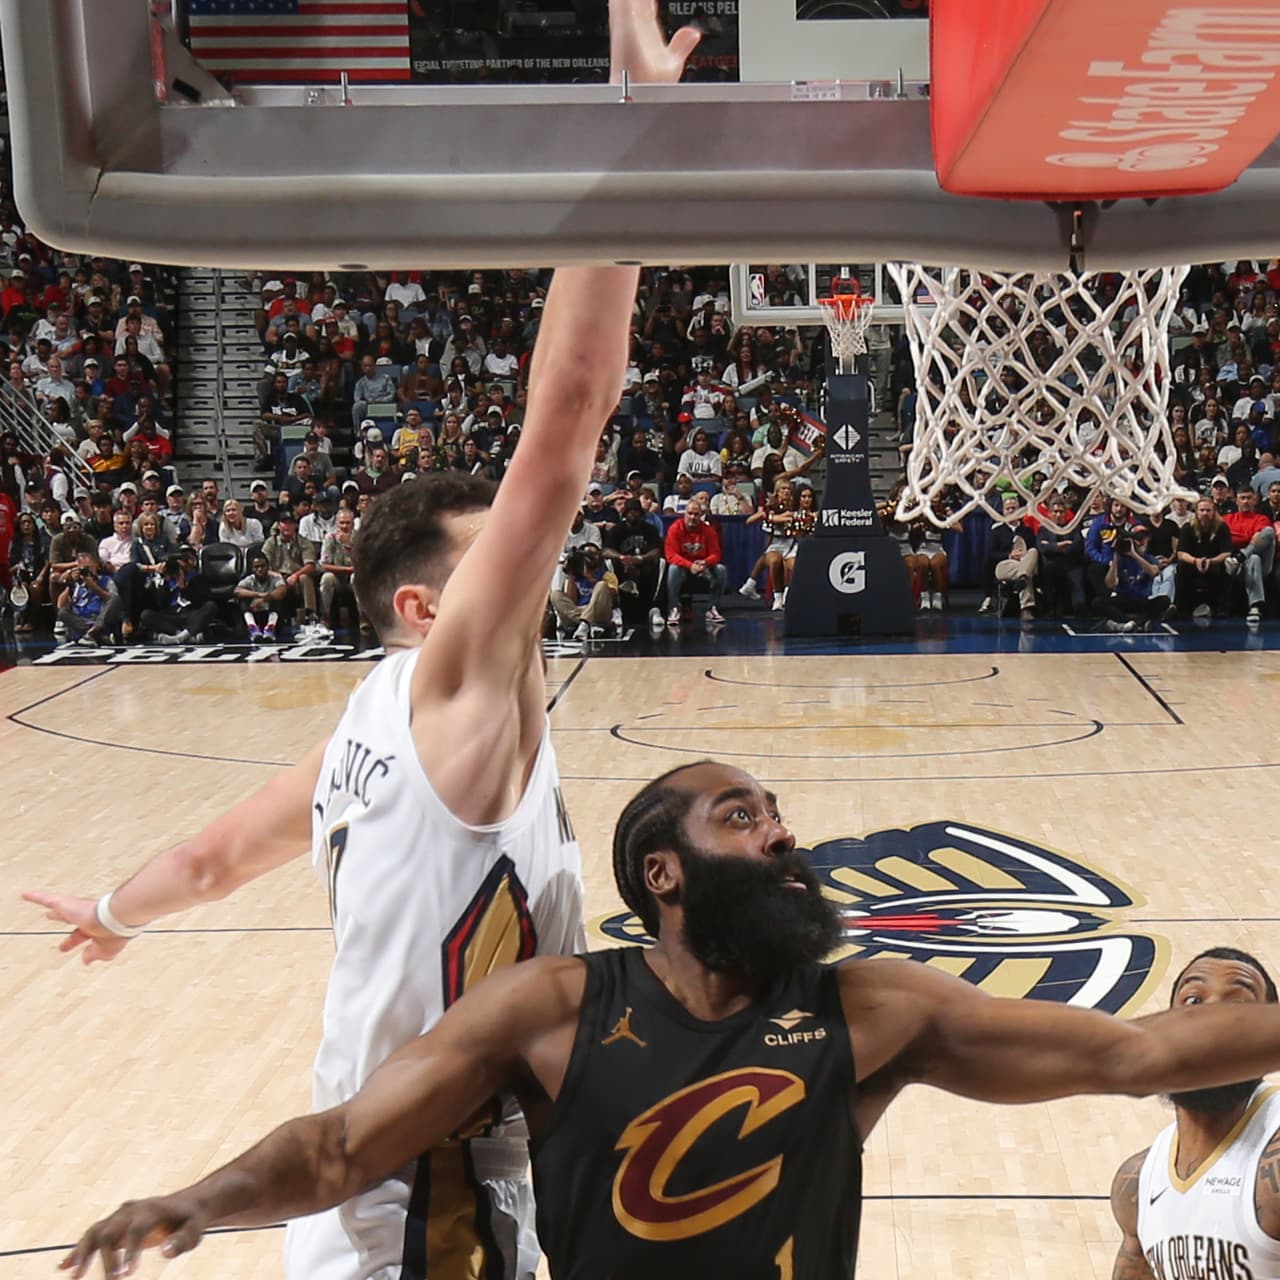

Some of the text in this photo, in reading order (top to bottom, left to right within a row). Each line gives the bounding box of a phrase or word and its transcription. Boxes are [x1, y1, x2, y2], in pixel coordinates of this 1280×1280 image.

[840, 508, 873, 517] Keesler
[840, 517, 873, 527] Federal
[764, 1027, 826, 1046] CLIFFS
